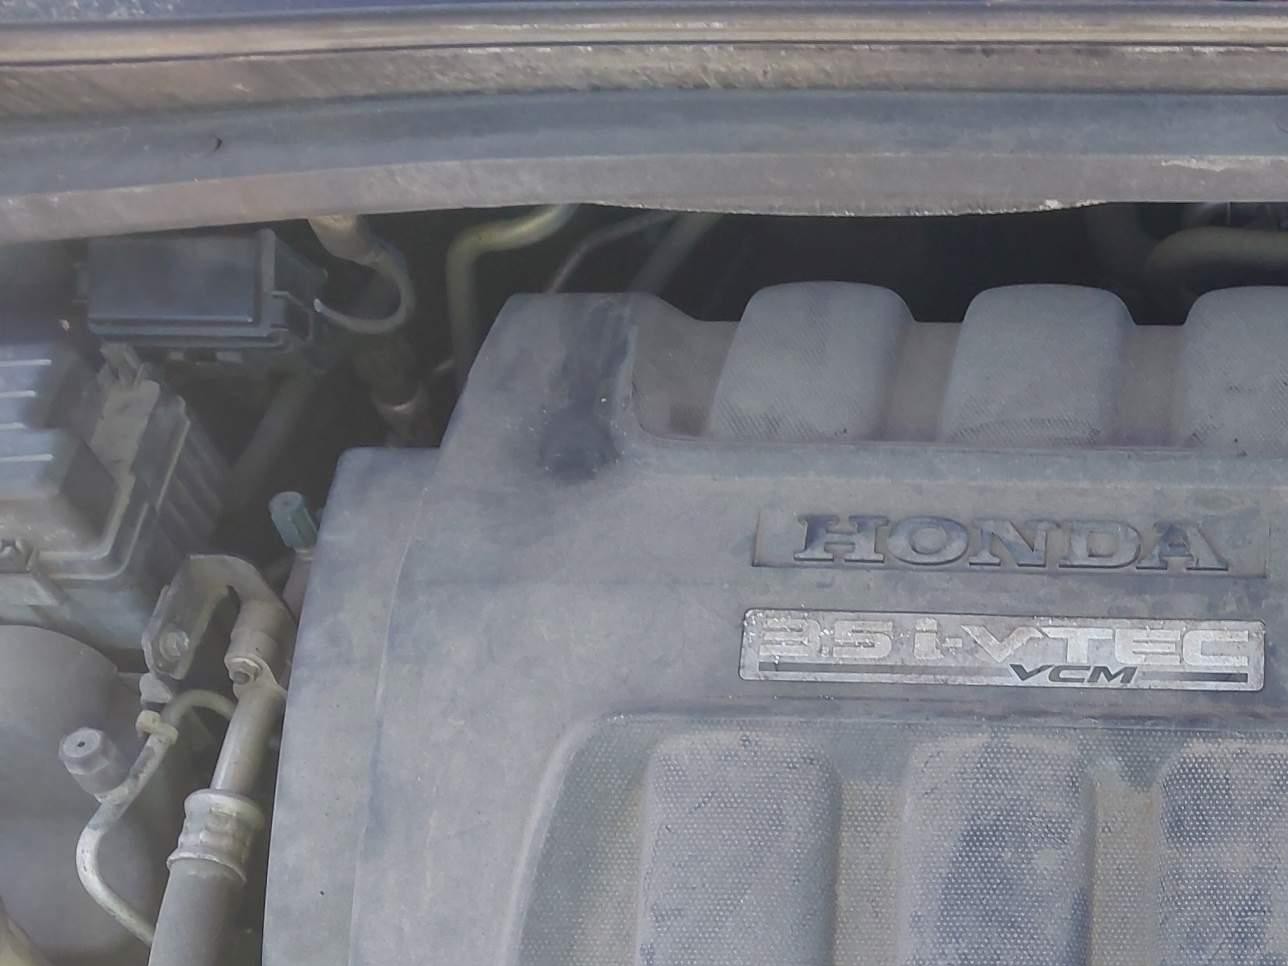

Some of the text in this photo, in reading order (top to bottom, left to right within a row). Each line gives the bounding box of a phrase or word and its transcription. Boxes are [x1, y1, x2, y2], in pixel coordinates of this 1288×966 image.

[794, 515, 1229, 571] HONDA
[913, 617, 1250, 667] i-VTEC
[1008, 664, 1138, 684] VCM
